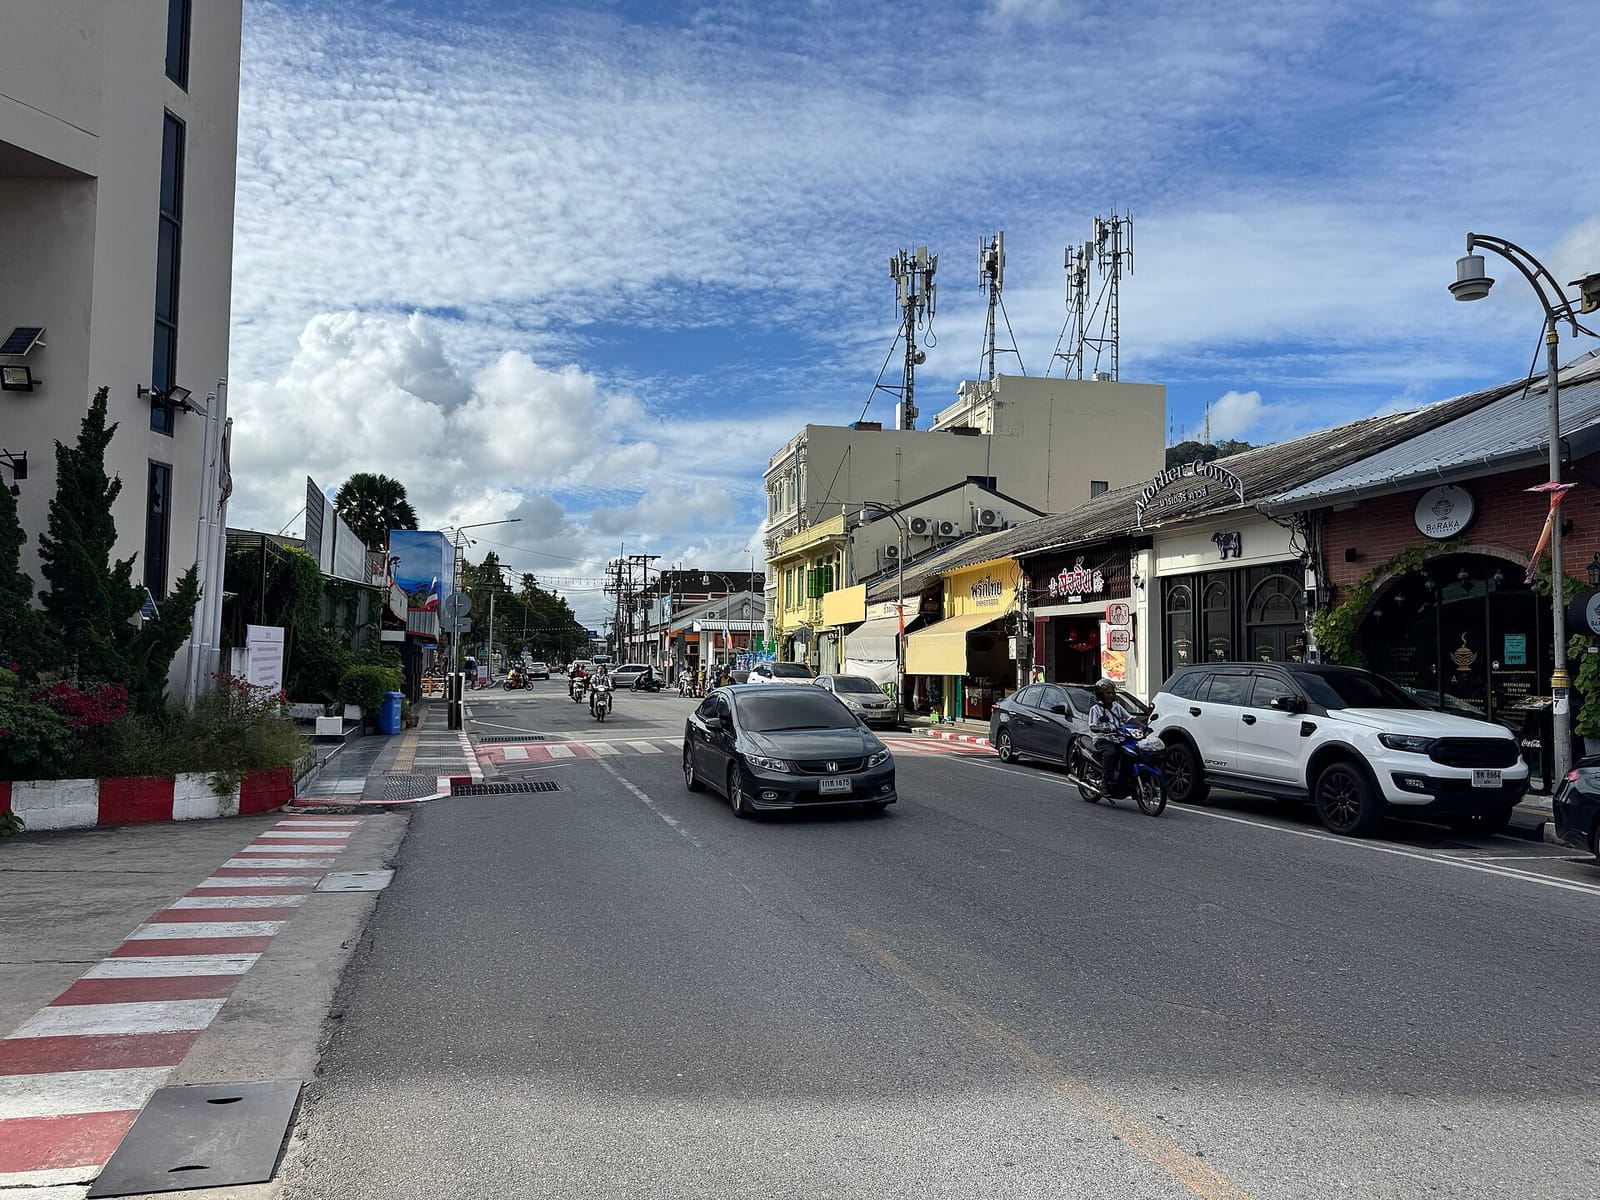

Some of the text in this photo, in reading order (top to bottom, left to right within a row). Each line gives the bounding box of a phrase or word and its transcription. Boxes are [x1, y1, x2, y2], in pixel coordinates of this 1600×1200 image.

[1135, 460, 1236, 511] Mother Cows
[1426, 520, 1459, 531] BARAKA
[971, 575, 1003, 599] พริกไทย
